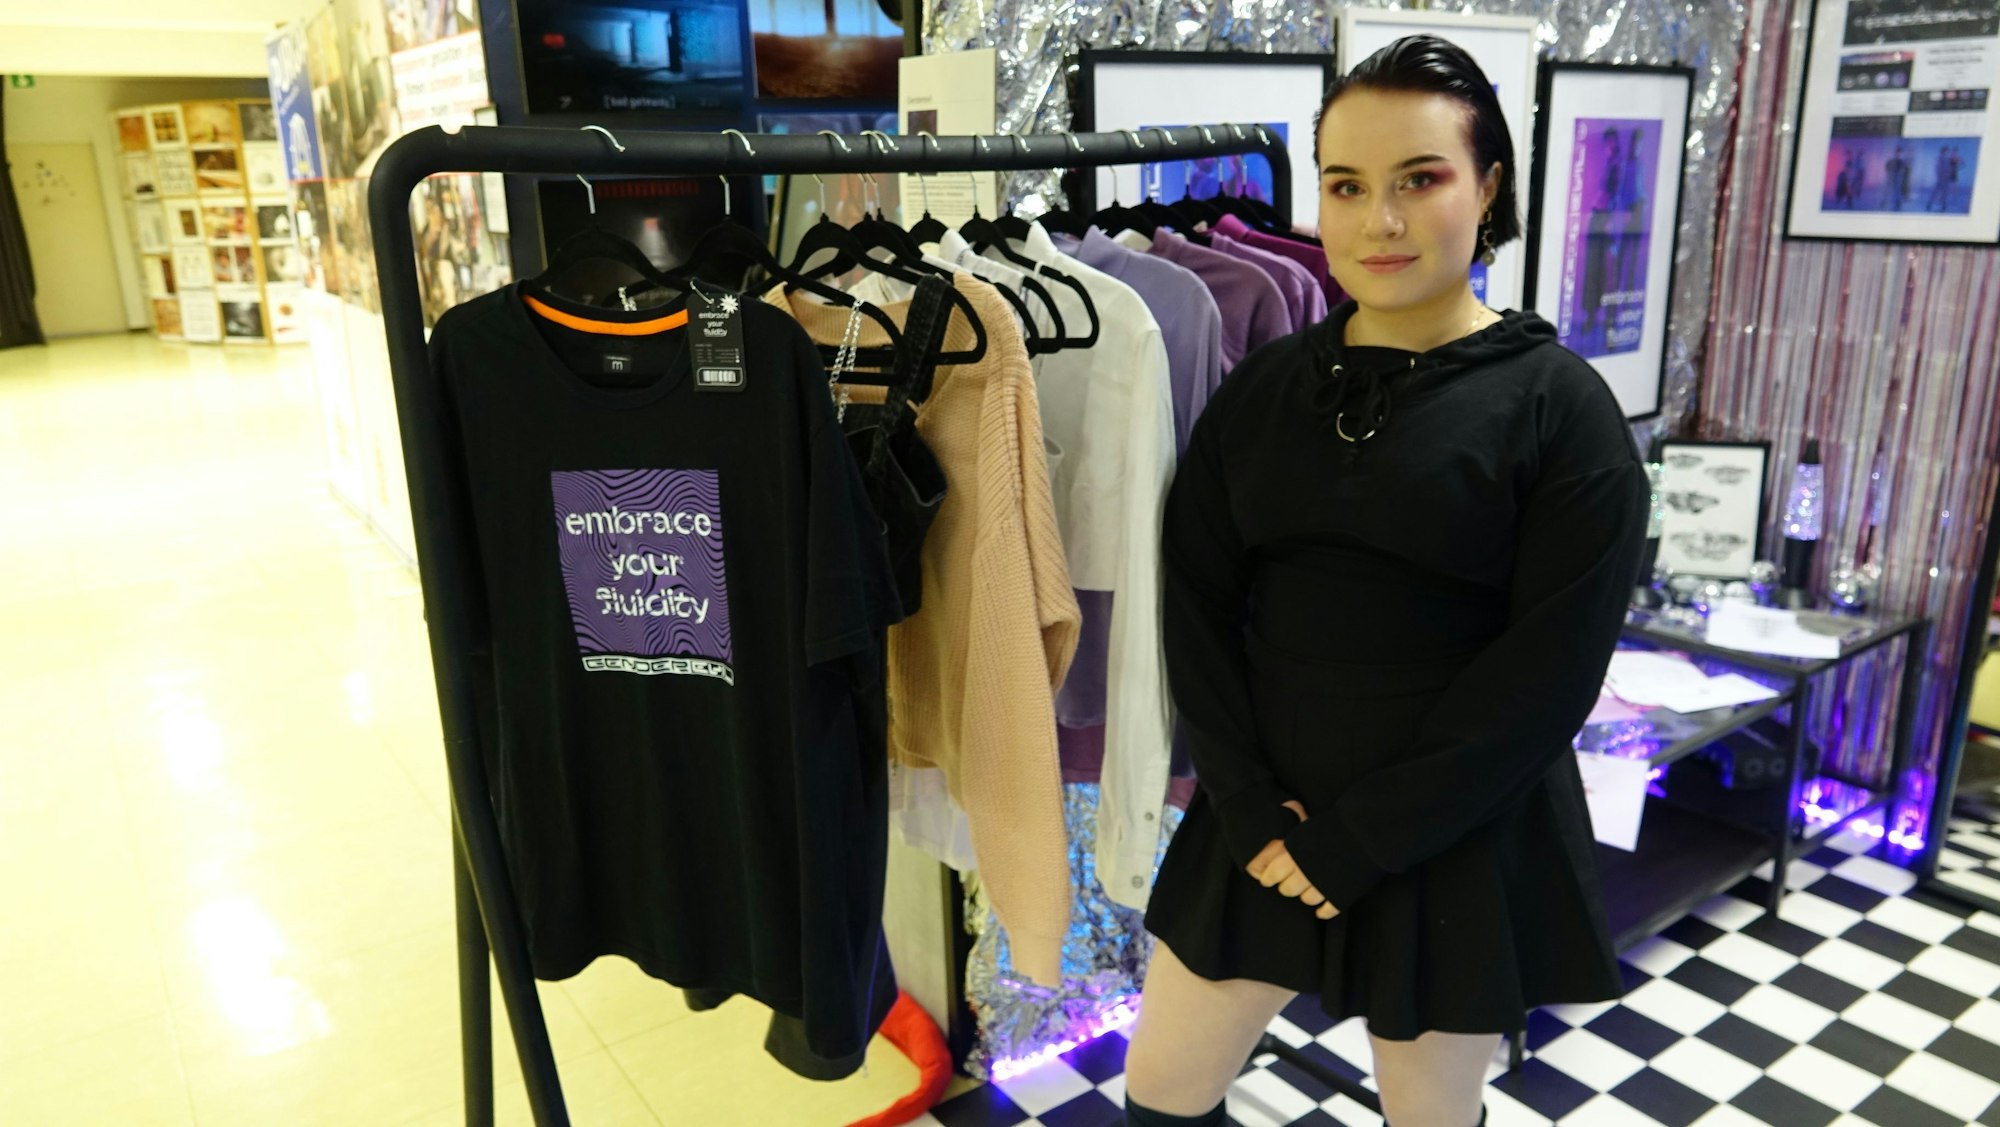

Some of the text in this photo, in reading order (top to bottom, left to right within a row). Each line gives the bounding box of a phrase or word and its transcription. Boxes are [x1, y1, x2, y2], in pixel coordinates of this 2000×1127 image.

[698, 311, 730, 319] embrace
[706, 321, 724, 329] your
[565, 506, 713, 537] embrace
[608, 553, 685, 581] your
[595, 586, 710, 624] fluidity
